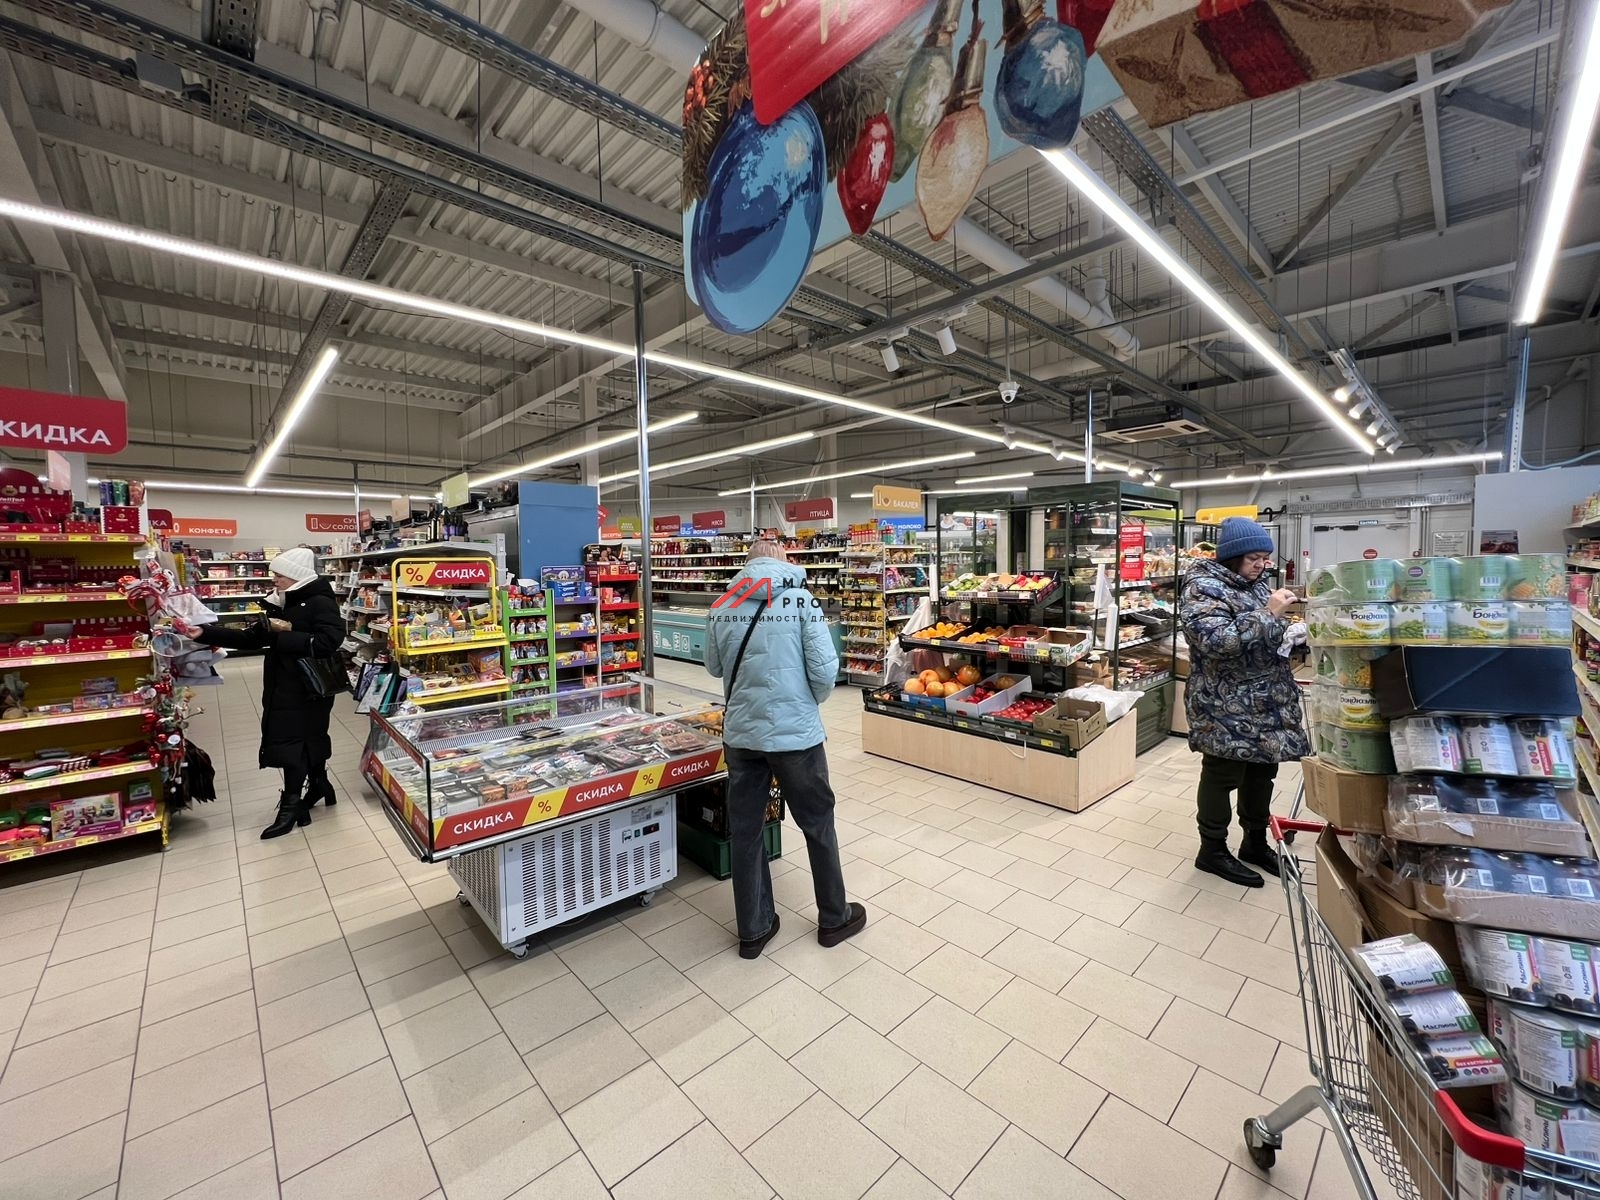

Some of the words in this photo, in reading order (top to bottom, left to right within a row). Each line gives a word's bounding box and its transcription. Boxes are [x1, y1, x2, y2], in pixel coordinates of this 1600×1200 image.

[434, 568, 485, 579] СКИДКА
[453, 811, 514, 835] СКИДКА
[575, 782, 624, 803] СКИДКА
[671, 760, 710, 777] СКИДКА
[1516, 952, 1527, 984] Маслины
[1400, 978, 1434, 987] Маслины
[1580, 962, 1591, 995] Маслины
[1422, 1022, 1457, 1031] Маслины
[1437, 1046, 1472, 1054] Маслины
